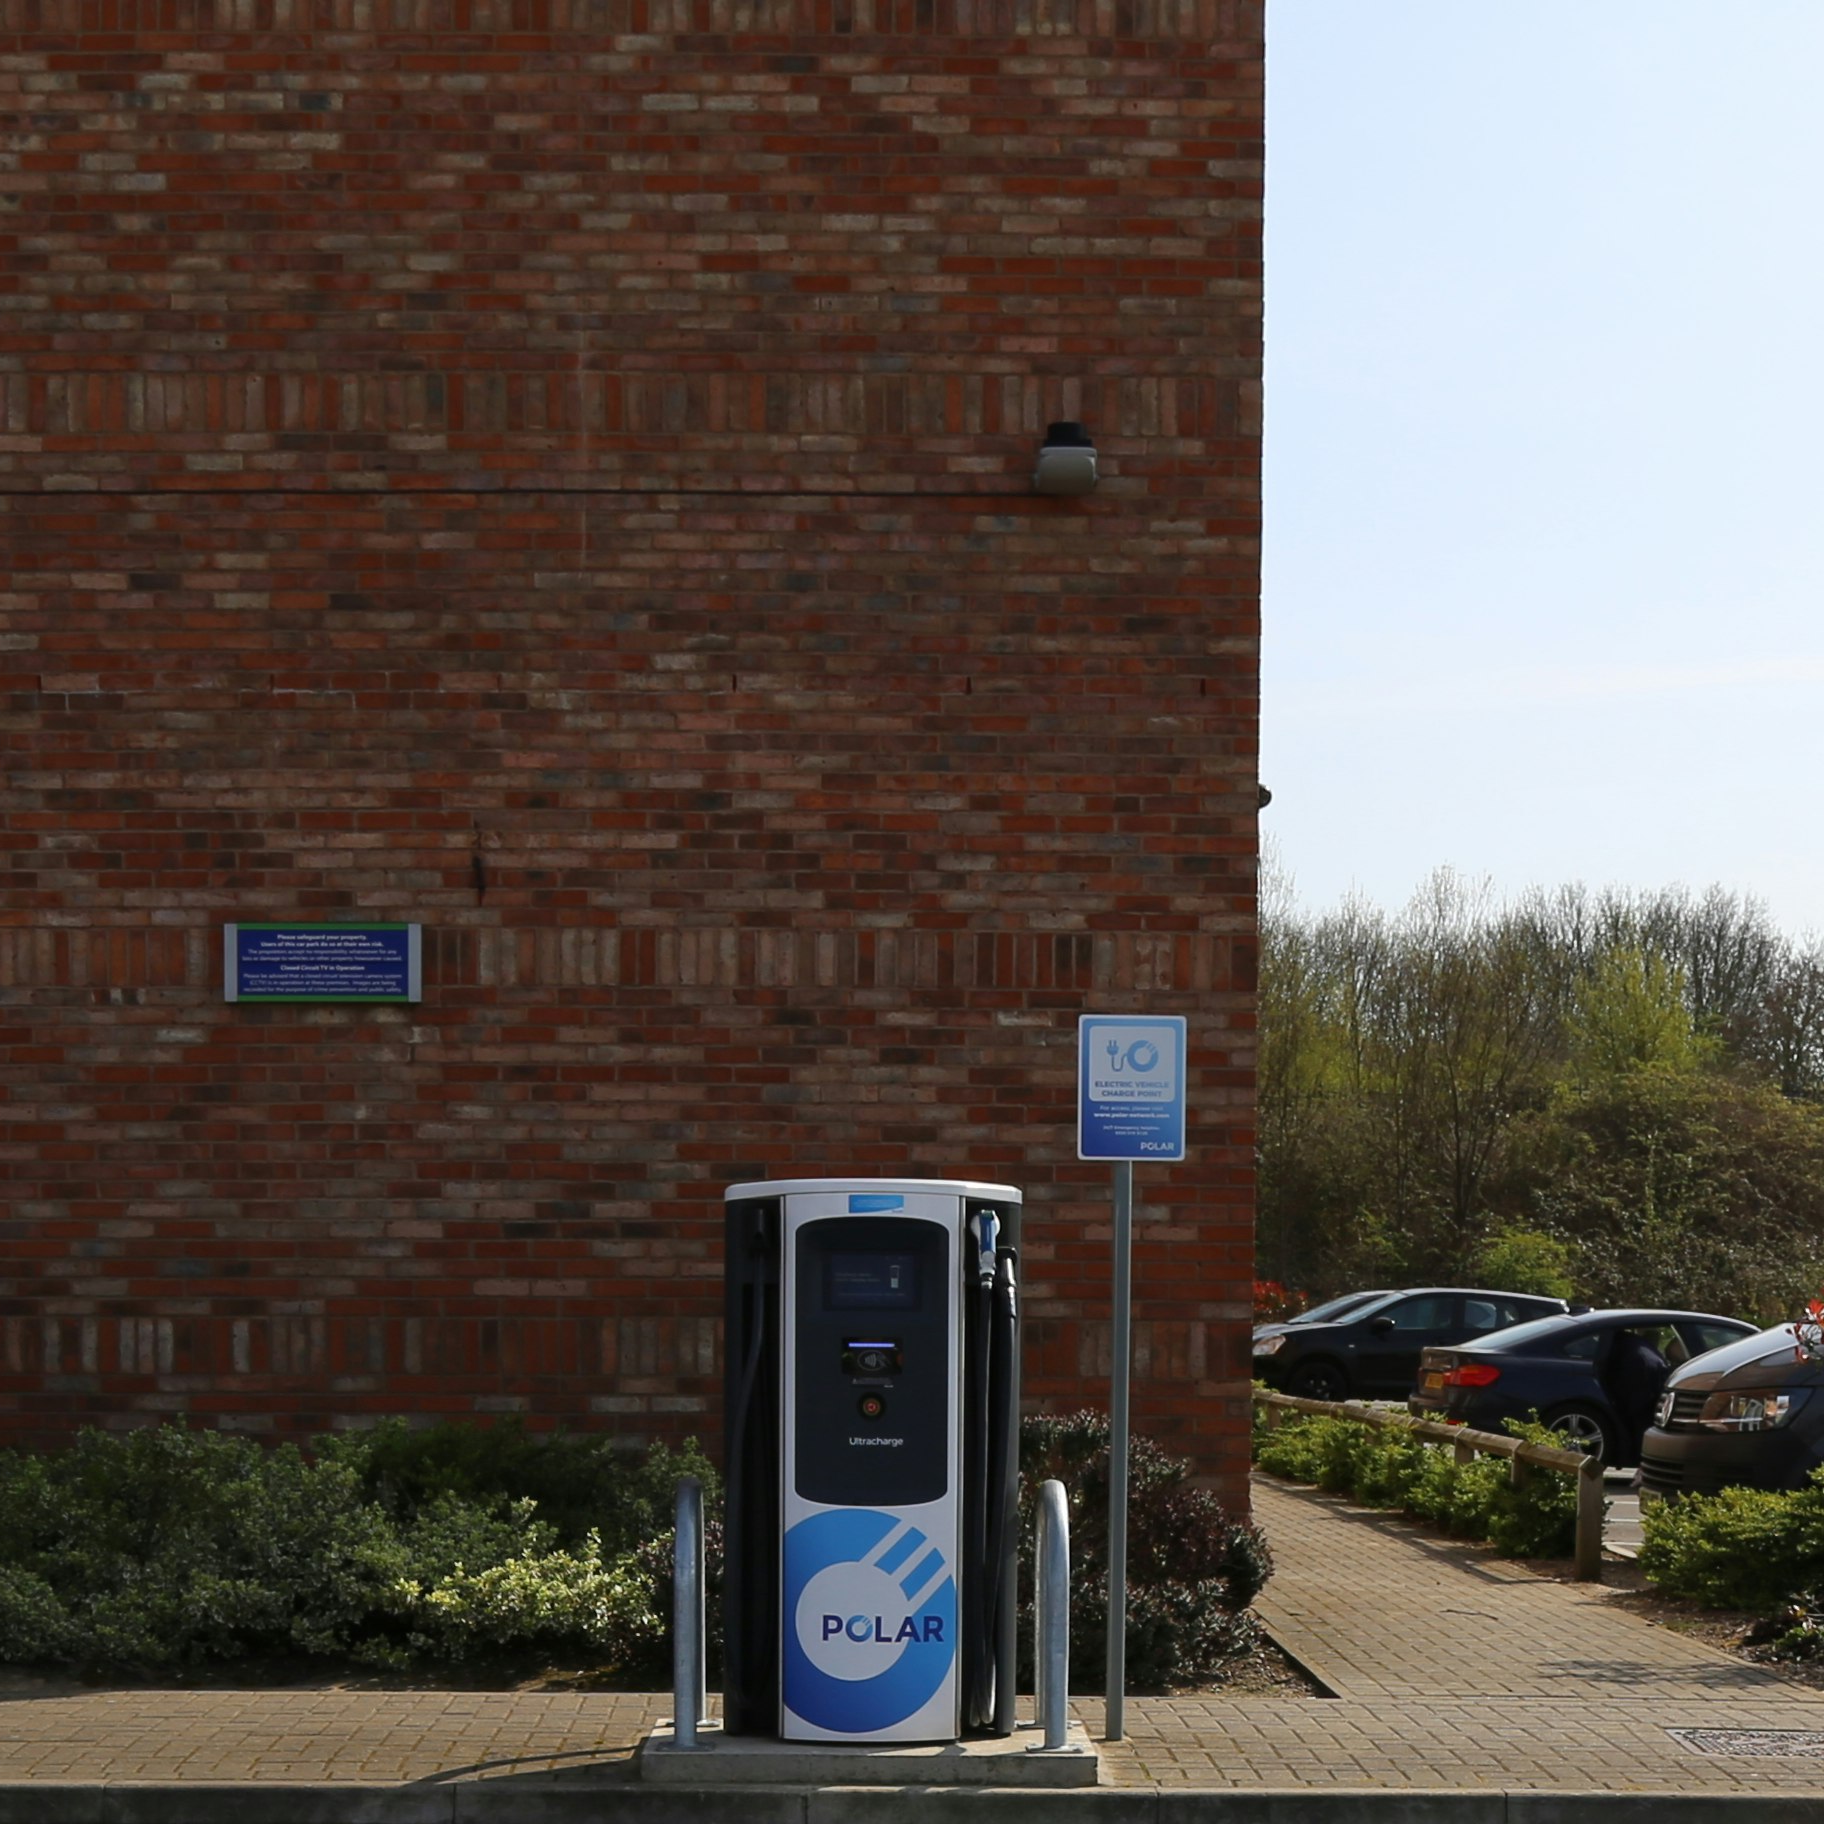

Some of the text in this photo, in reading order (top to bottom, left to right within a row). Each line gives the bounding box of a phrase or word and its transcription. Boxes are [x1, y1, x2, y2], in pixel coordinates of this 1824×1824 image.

[1140, 1142, 1174, 1150] POLAR
[849, 1437, 903, 1447] Ultracharge
[822, 1614, 944, 1643] POLAR
